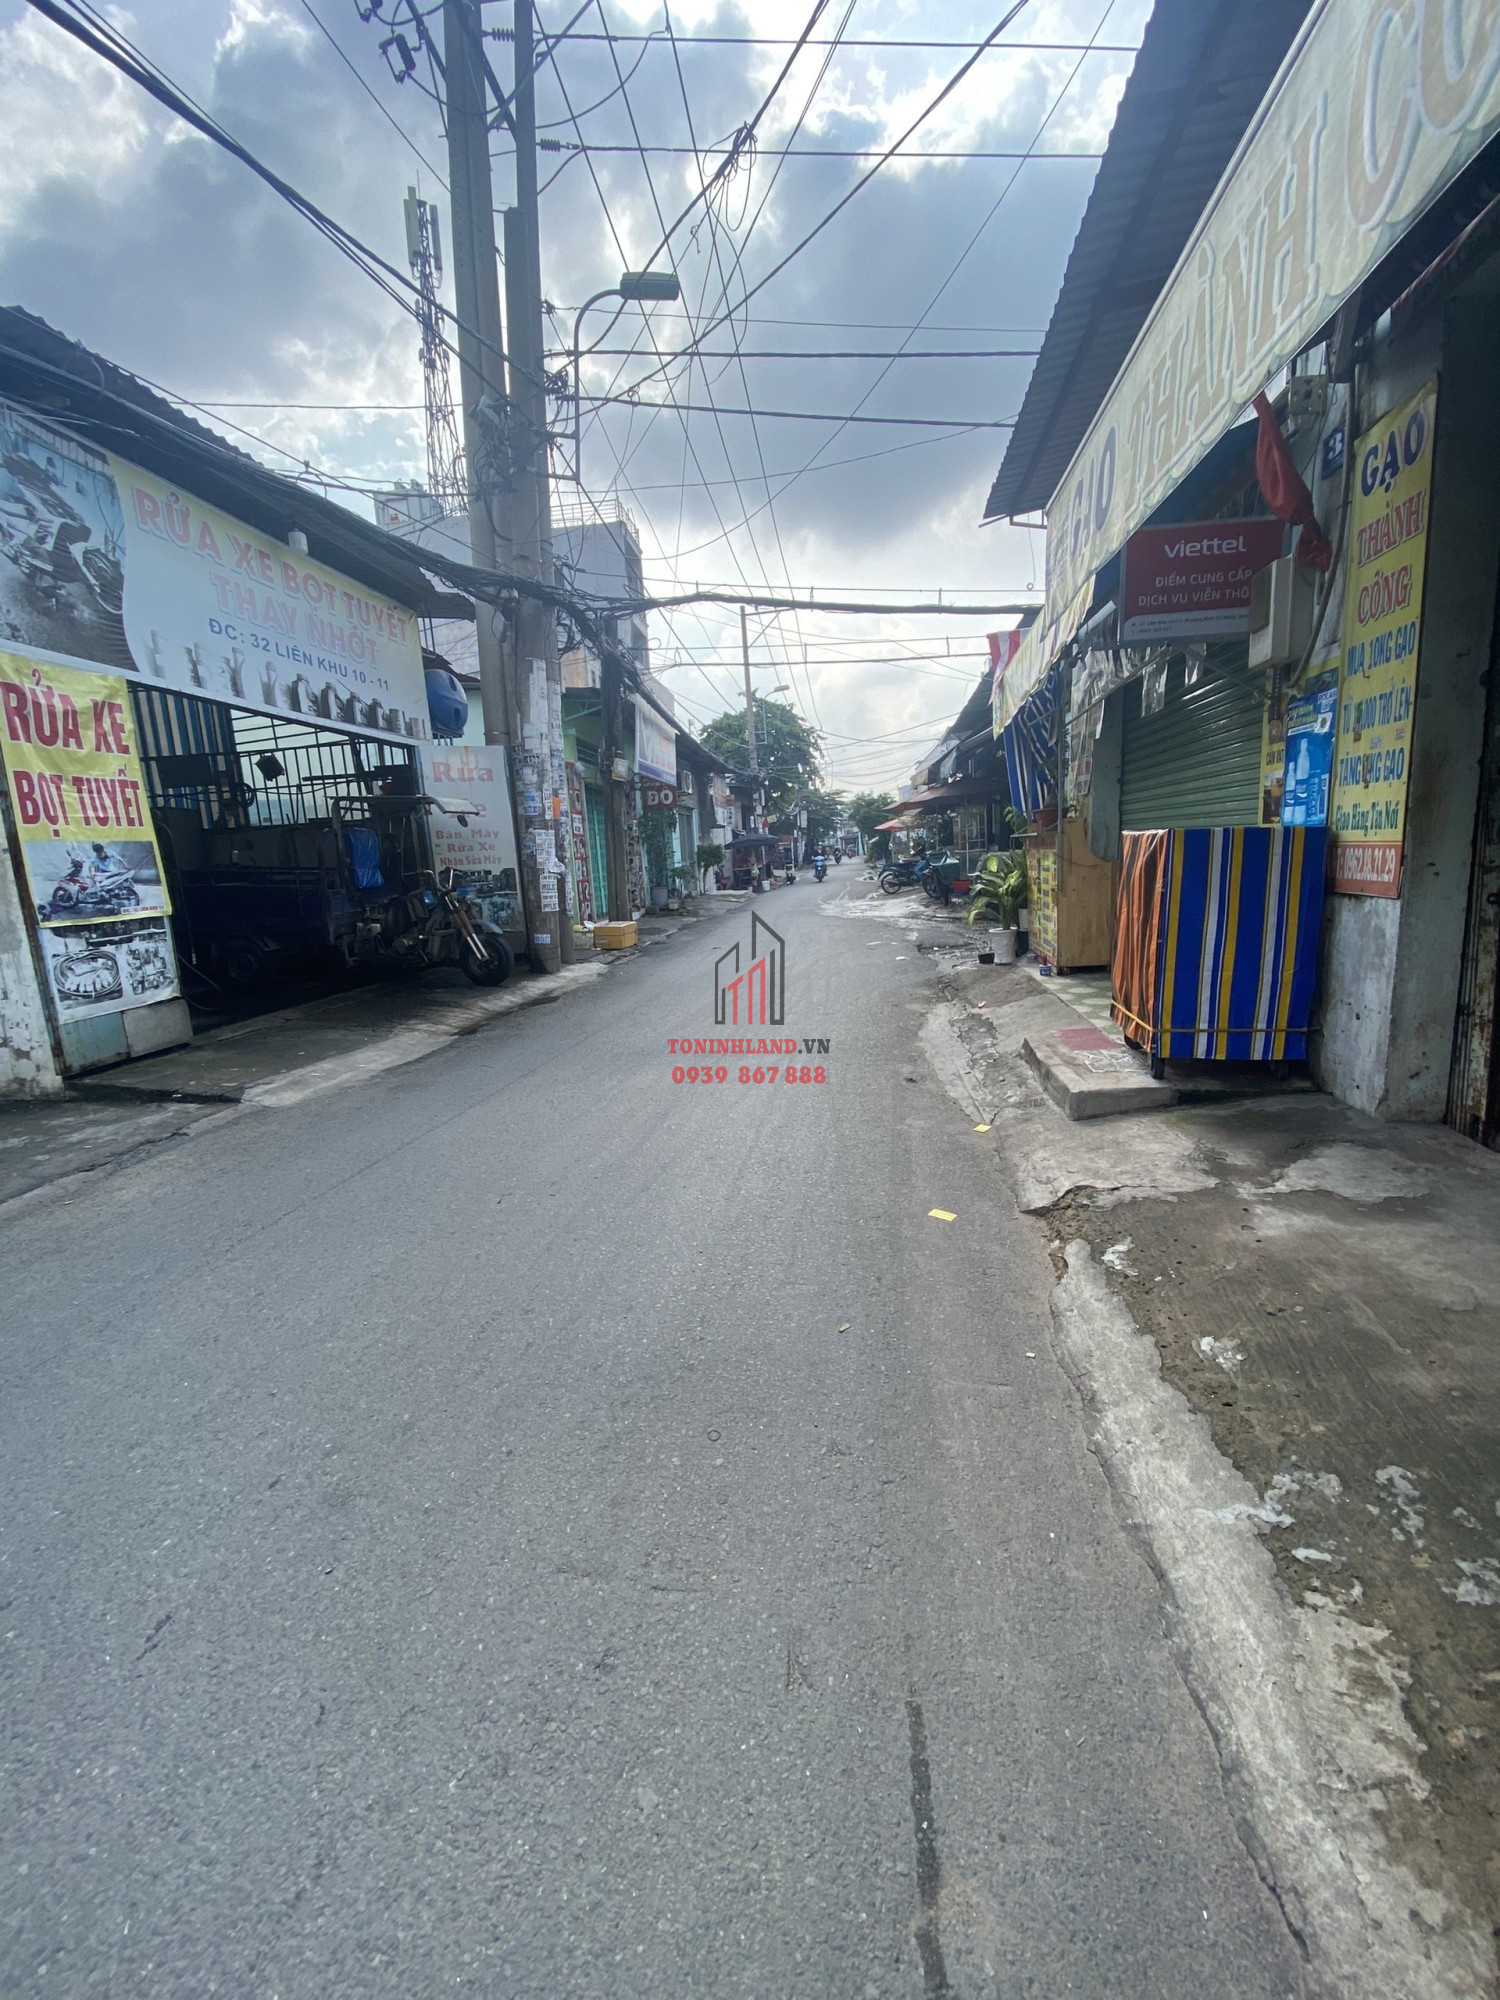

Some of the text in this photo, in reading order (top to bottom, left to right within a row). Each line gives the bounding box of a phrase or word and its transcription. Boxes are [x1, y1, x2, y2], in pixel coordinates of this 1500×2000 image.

[1360, 409, 1427, 497] GẠO
[1165, 535, 1247, 558] viettel
[1356, 489, 1425, 568] THÀNH
[132, 485, 408, 646] RỬA XE BỌT TUYẾT
[1156, 566, 1252, 587] ĐIỂM CUNG CẤP
[209, 571, 299, 639] THAY
[1138, 585, 1250, 608] DỊCH VỤ VIỄN THÔ
[208, 617, 245, 645] ĐC:
[250, 632, 270, 653] 32
[275, 641, 314, 668] LIÊN
[317, 656, 348, 678] KHU
[351, 669, 366, 684] 10
[377, 678, 389, 692] 11
[1347, 620, 1417, 677] MUA 10KG GẠO
[0, 668, 131, 756] RỬA XE
[1394, 677, 1412, 722] LÊN
[1339, 752, 1361, 796] TẶNG
[1383, 747, 1405, 789] GẠO
[12, 764, 144, 838] BỌT TUYẾT
[1335, 804, 1351, 831] Giao
[1351, 801, 1370, 837] Hàng
[440, 856, 464, 868] Nhận
[478, 842, 496, 851] Xe
